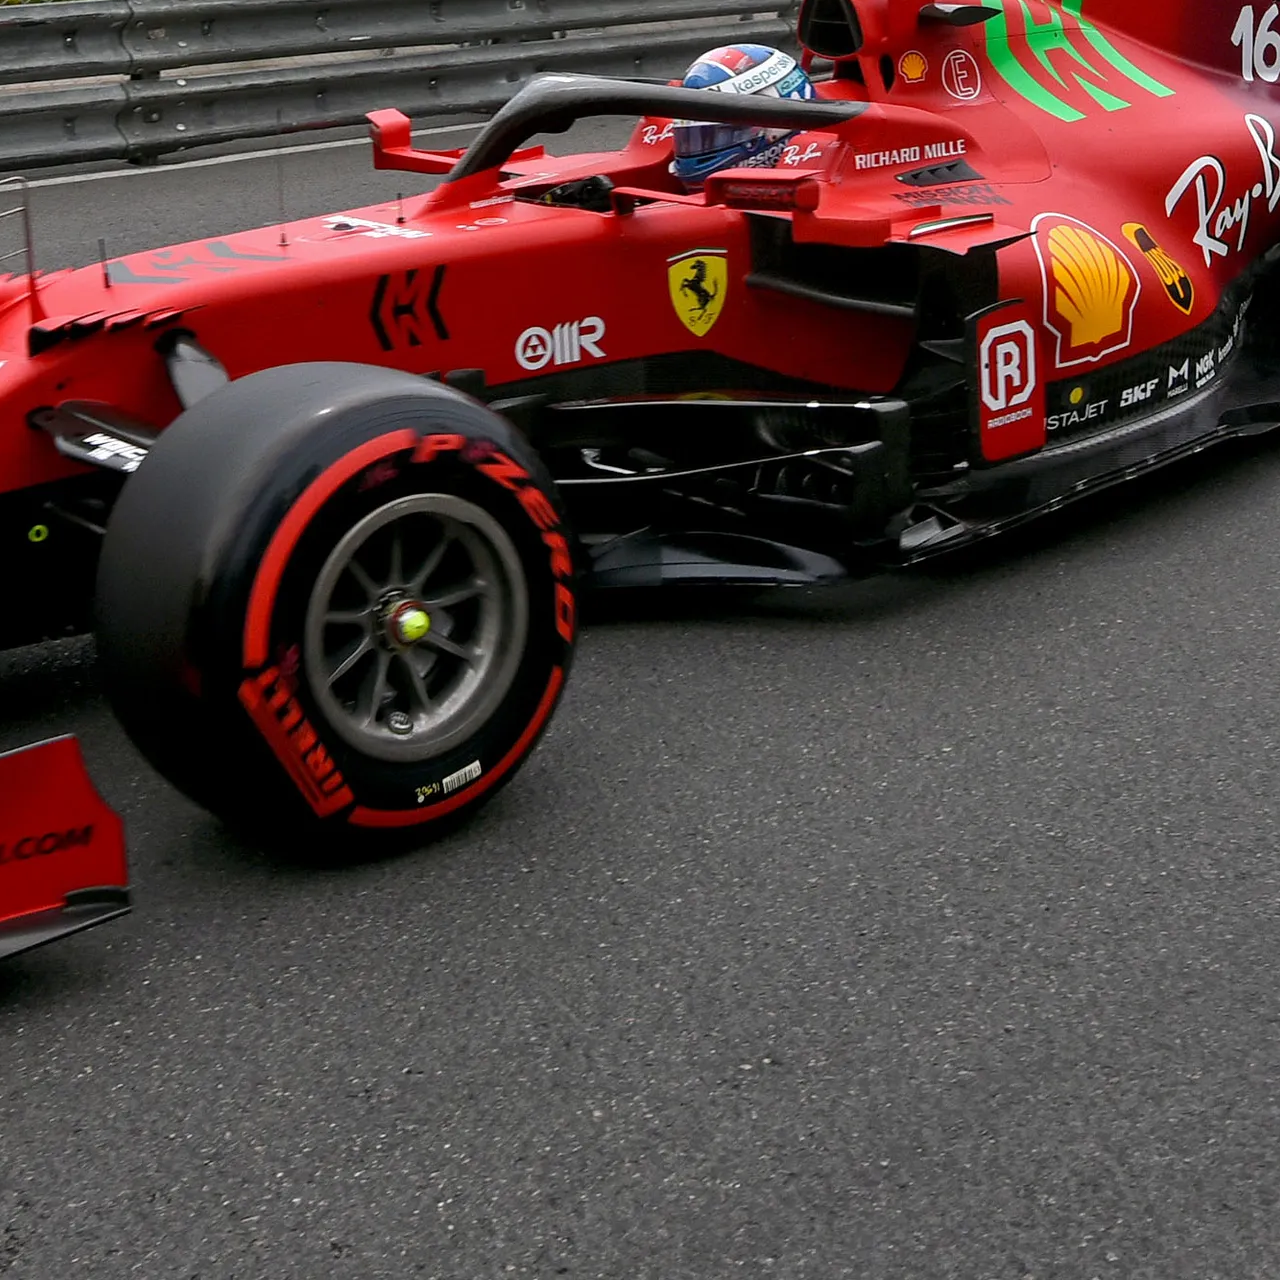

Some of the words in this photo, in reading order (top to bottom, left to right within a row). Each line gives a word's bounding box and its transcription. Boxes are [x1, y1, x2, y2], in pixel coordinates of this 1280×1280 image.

[854, 146, 920, 170] RICHARD
[924, 139, 967, 160] MILLE
[890, 184, 996, 202] MISSION
[1195, 349, 1215, 381] NGK
[1120, 378, 1160, 408] SKF
